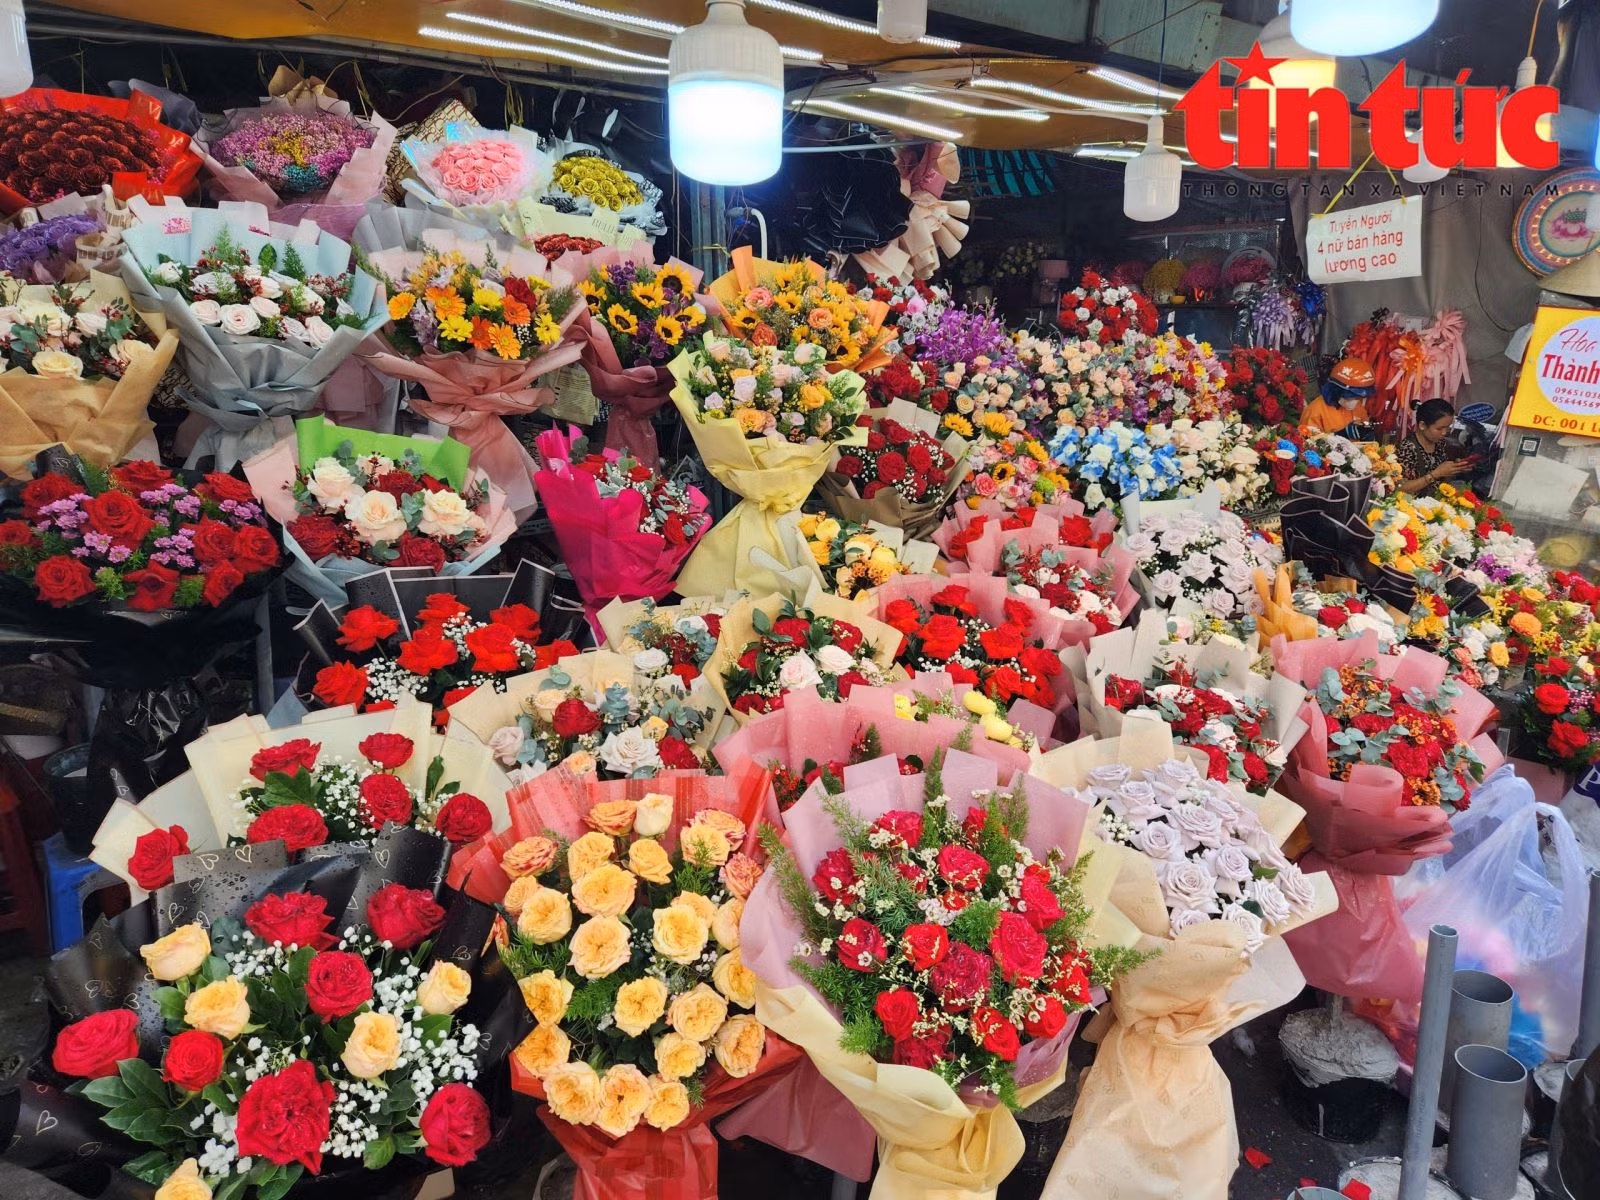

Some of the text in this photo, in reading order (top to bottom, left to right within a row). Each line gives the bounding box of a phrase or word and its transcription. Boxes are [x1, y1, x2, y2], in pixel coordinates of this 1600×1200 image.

[1317, 230, 1404, 255] 4 nữ bán hàng
[1324, 252, 1398, 274] lương cao
[1559, 328, 1598, 353] Hoa
